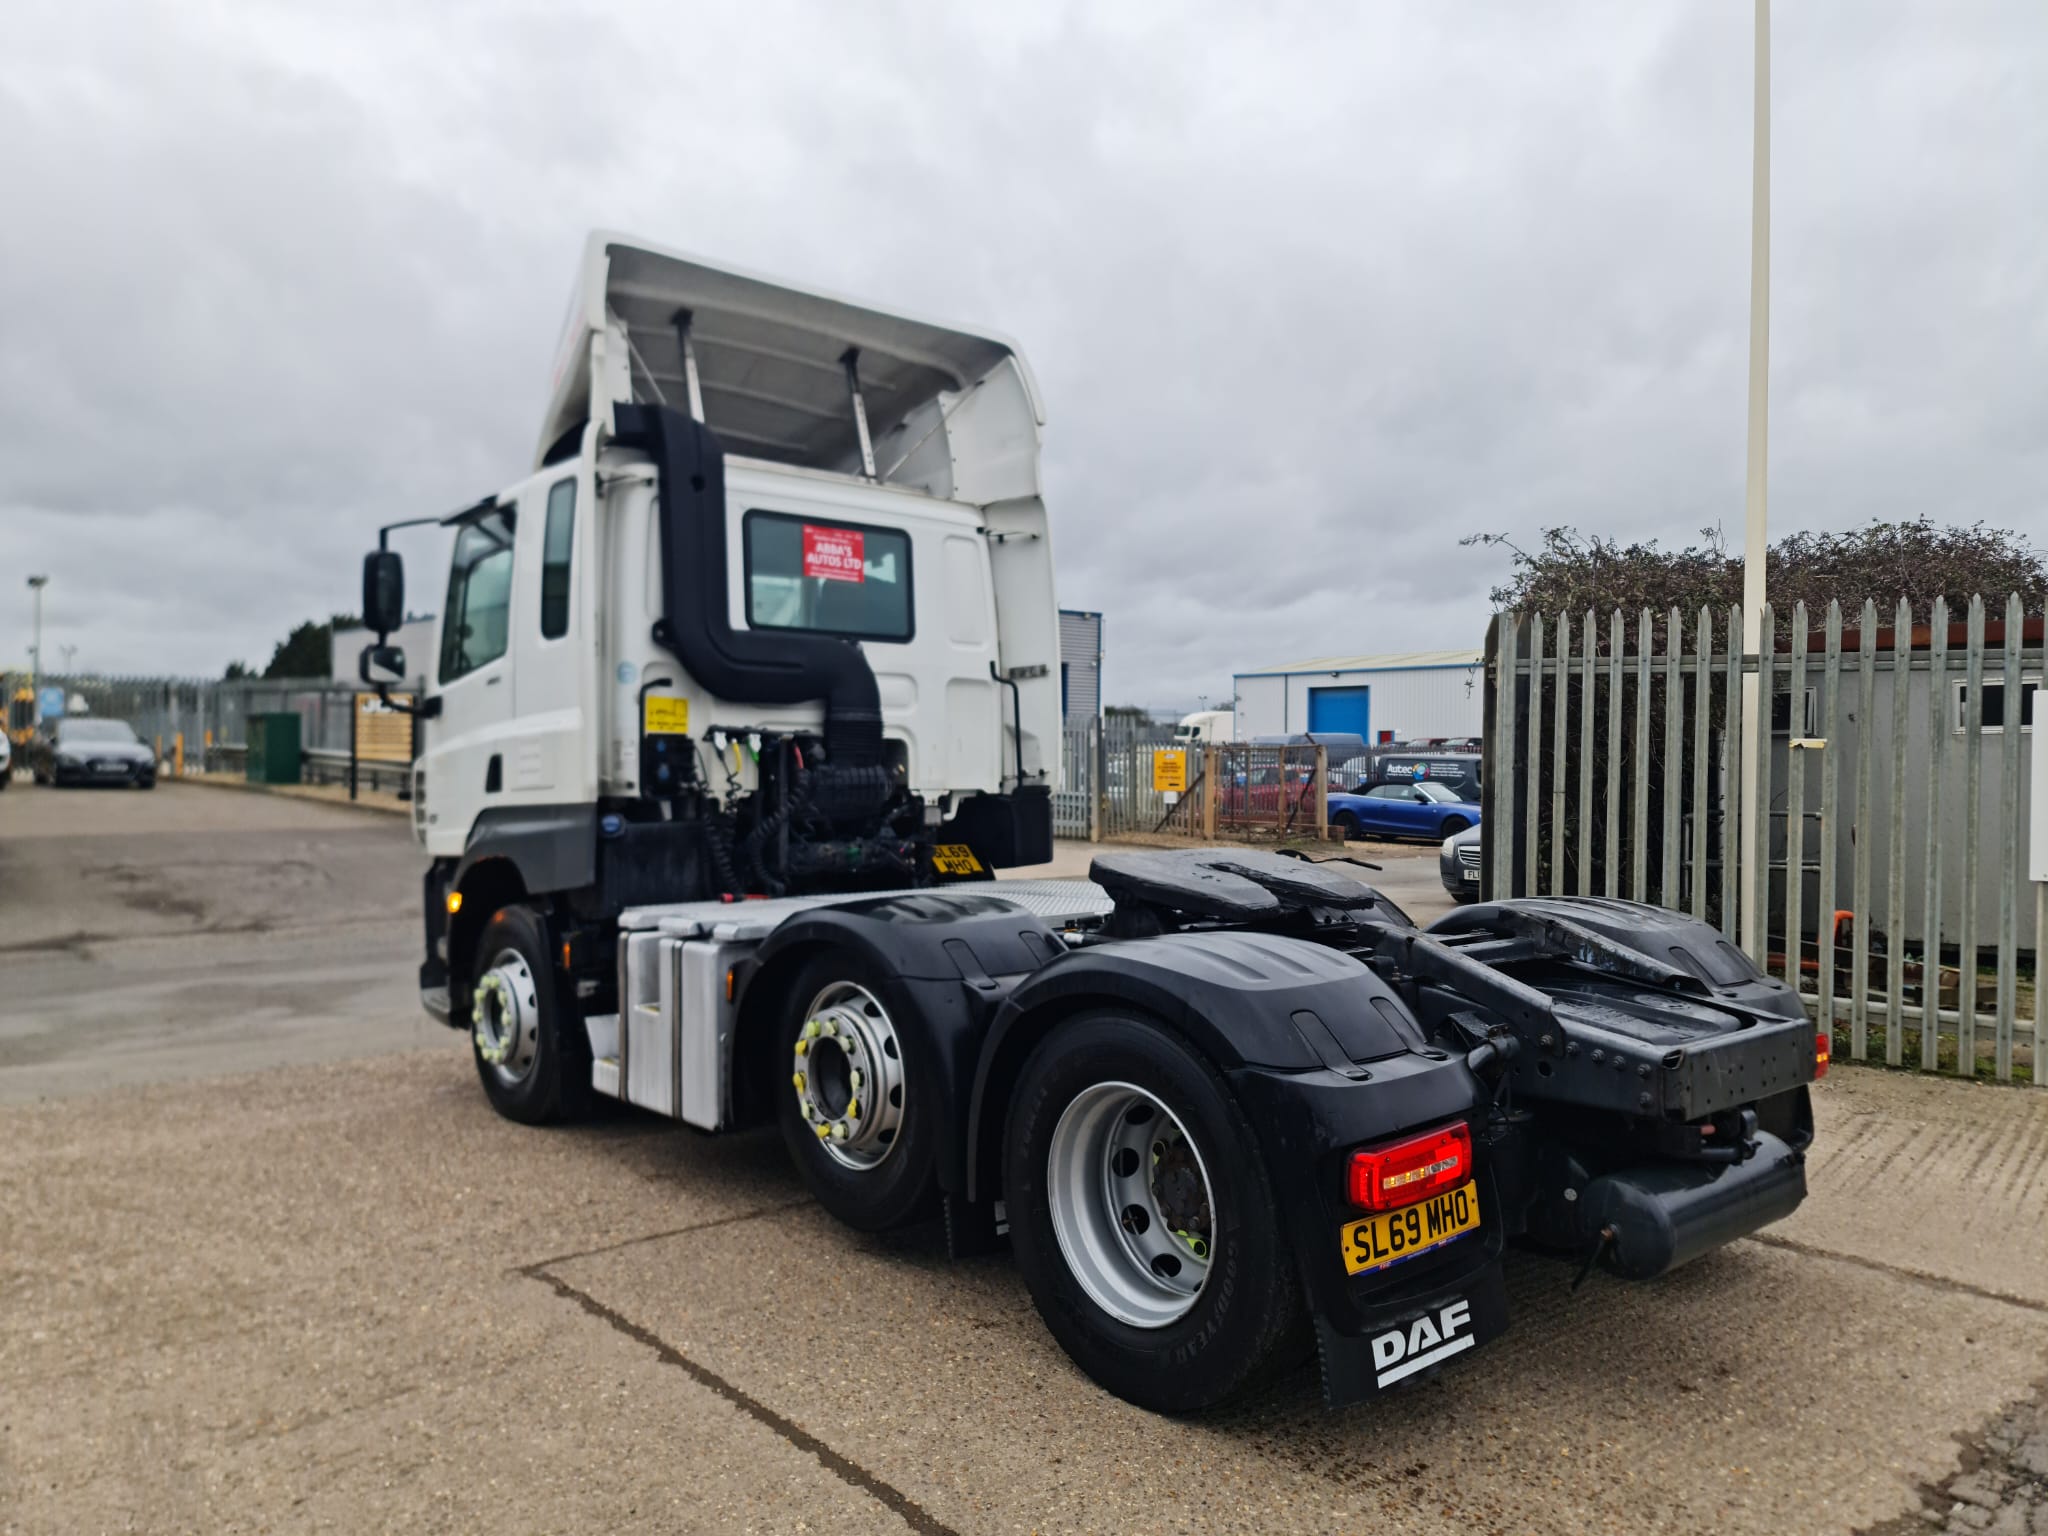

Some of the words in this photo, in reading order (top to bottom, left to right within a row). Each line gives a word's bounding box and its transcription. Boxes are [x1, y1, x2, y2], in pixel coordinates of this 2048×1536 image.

[807, 552, 841, 567] AUTOS
[843, 558, 862, 570] LTD
[935, 846, 970, 858] SL69
[1353, 1208, 1421, 1264] SL69
[1427, 1190, 1470, 1241] MHO
[1371, 1300, 1471, 1371] DAF
